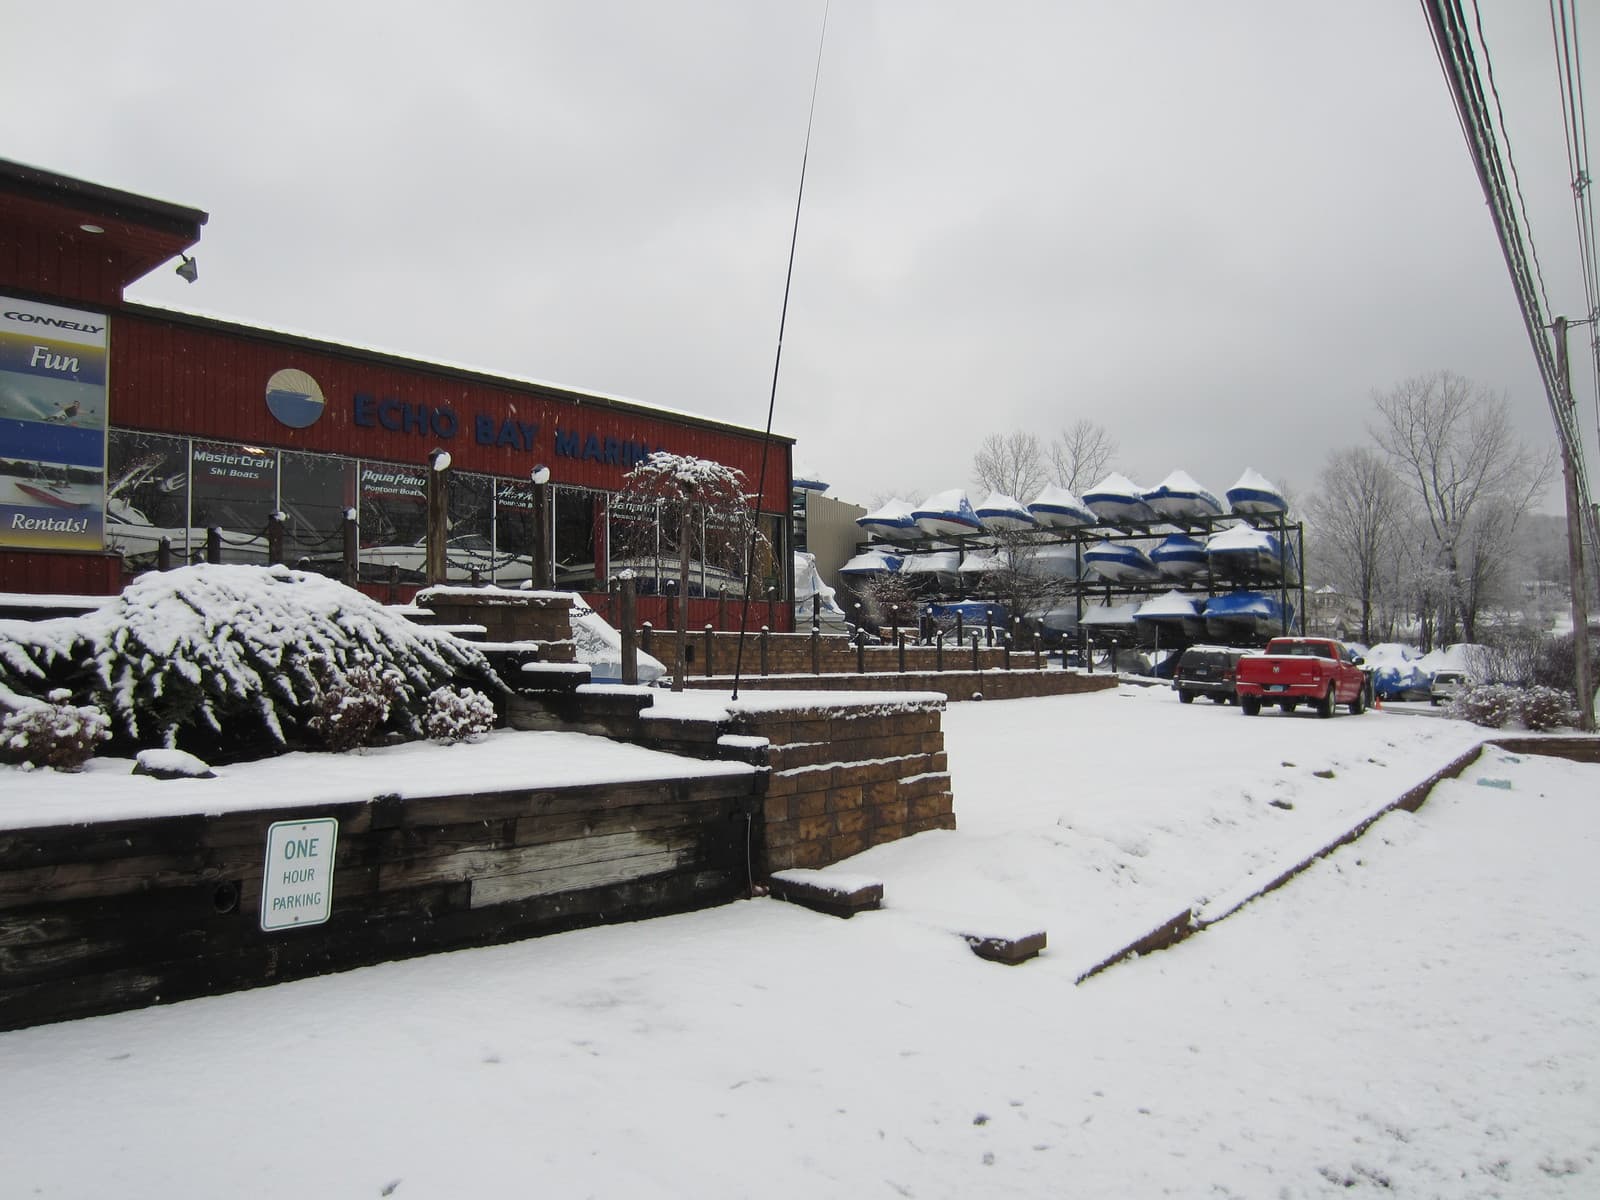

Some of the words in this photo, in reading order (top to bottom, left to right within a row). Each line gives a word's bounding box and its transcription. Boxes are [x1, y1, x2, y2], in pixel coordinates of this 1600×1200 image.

[3, 311, 105, 334] CONNELLY
[30, 345, 80, 373] Fun
[353, 393, 459, 439] ECHO
[474, 414, 539, 452] BAY
[554, 427, 666, 468] MARIN
[193, 450, 275, 469] MasterCraft
[210, 467, 227, 476] Ski
[229, 469, 260, 479] Boats
[365, 485, 398, 494] Pontoon
[11, 513, 88, 534] Rentals!
[284, 838, 319, 860] ONE
[282, 868, 315, 885] HOUR
[272, 892, 322, 911] PARKING
